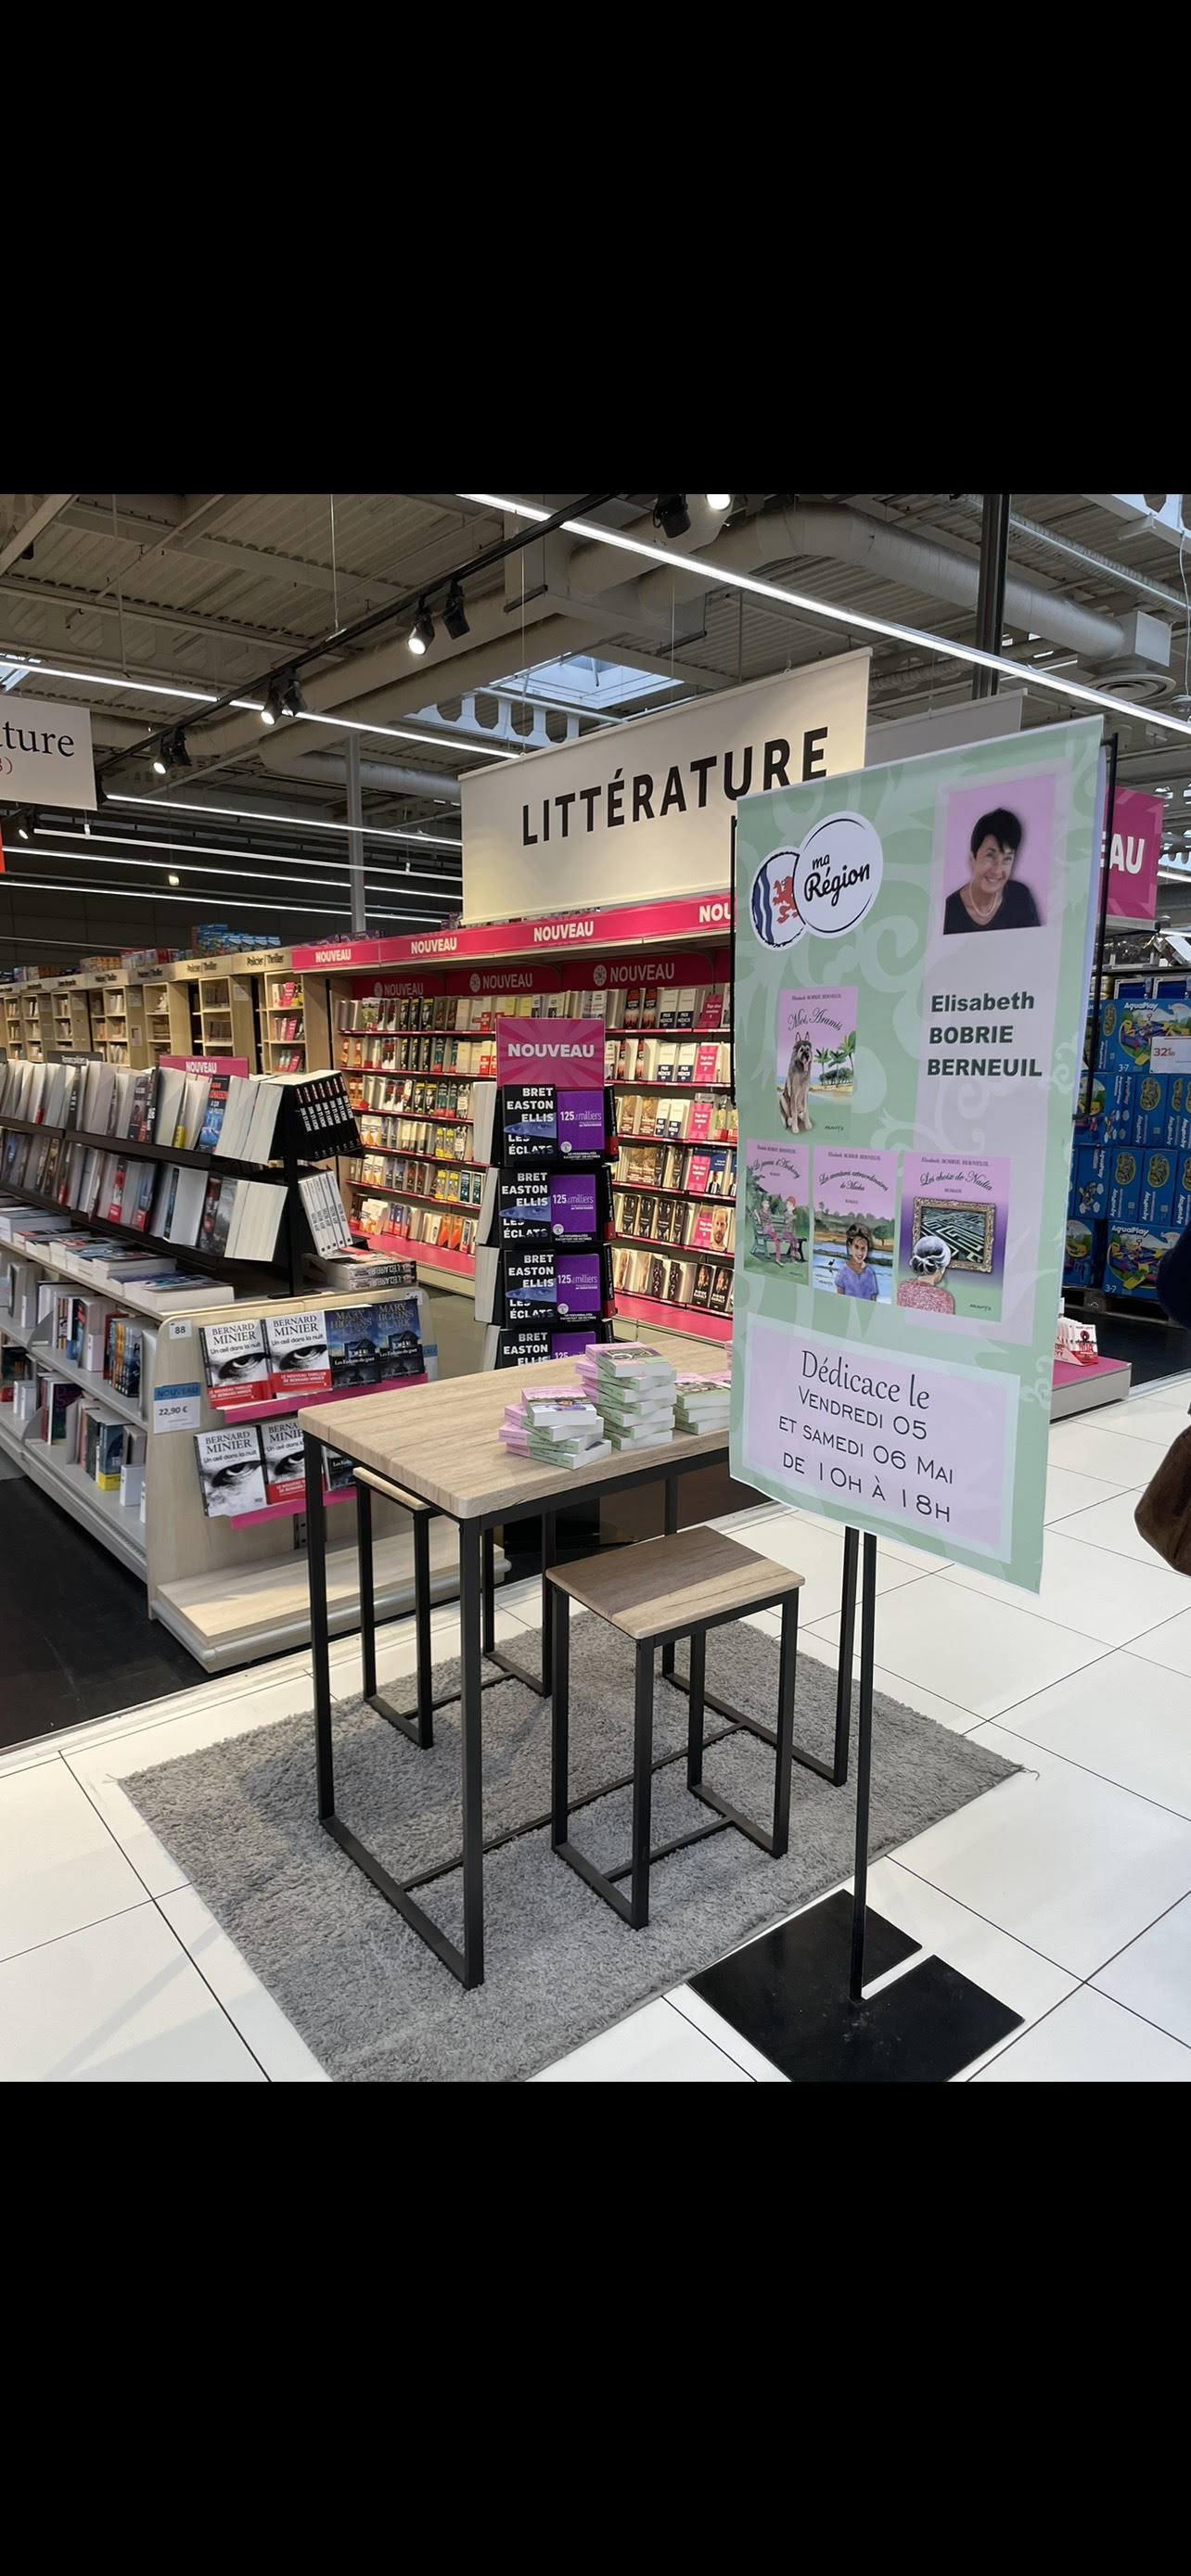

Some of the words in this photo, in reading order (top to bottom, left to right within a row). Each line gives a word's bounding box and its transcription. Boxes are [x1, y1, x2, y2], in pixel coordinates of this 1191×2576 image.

[0, 721, 74, 757] ture
[522, 726, 828, 846] LITTÉRATURE
[813, 854, 830, 870] ma
[804, 863, 870, 907] Région
[699, 902, 731, 923] NOU
[533, 921, 594, 941] NOUVEAU
[411, 937, 457, 953] NOUVEAU
[315, 949, 352, 963] NOUVEAU
[610, 963, 674, 982] NOUVEAU
[482, 973, 533, 988] NOUVEAU
[384, 982, 424, 996] NOUVEAU
[931, 991, 1034, 1013] Elisabeth
[1124, 1001, 1158, 1012] AquaPlay
[929, 1026, 1014, 1044] BOBRIE
[508, 1043, 595, 1058] NOUVEAU
[186, 1061, 217, 1074] NOUVEAU
[928, 1058, 1043, 1077] BERNEUIL
[522, 1088, 554, 1097] BRET
[506, 1101, 554, 1110] EASTON
[521, 1114, 554, 1123] ELLIS
[560, 1111, 575, 1121] 125
[508, 1144, 555, 1155] ÉCLATS
[518, 1172, 548, 1181] BRET
[936, 1171, 954, 1181] choix
[954, 1171, 965, 1180] de
[965, 1170, 992, 1191] Nadia
[502, 1185, 548, 1194] EASTON
[516, 1198, 548, 1206] ELLIS
[553, 1194, 567, 1204] 125
[504, 1229, 548, 1239] ÉCLATS
[1111, 1225, 1149, 1236] AquaPlay
[524, 1255, 554, 1264] BRET
[508, 1267, 554, 1276] EASTON
[522, 1279, 554, 1288] ELLIS
[557, 1275, 571, 1284] 125
[379, 1303, 406, 1313] MARY
[510, 1308, 554, 1320] ÉCLATS
[273, 1315, 316, 1328] BERNARD
[175, 1326, 186, 1334] 88
[212, 1323, 255, 1335] BERNARD
[275, 1322, 318, 1337] MINIER
[213, 1331, 256, 1345] MINIER
[519, 1333, 547, 1342] BRET
[504, 1345, 548, 1355] EASTON
[518, 1356, 548, 1366] ELLIS
[802, 1350, 901, 1403] Dédicace
[909, 1373, 929, 1409] le
[157, 1387, 198, 1397] NOUVEAU
[159, 1407, 181, 1416] 22,90
[799, 1385, 883, 1429] VENDREDI
[893, 1415, 928, 1440] 05
[269, 1422, 298, 1434] BERNA
[205, 1431, 250, 1444] BERNARD
[270, 1429, 303, 1443] MINIE
[206, 1439, 252, 1455] MINIER
[779, 1416, 797, 1434] ET
[802, 1424, 864, 1458] SAMEDI
[873, 1445, 906, 1470] 06
[917, 1456, 953, 1485] MAI
[783, 1452, 805, 1474] DE
[872, 1475, 886, 1501] À
